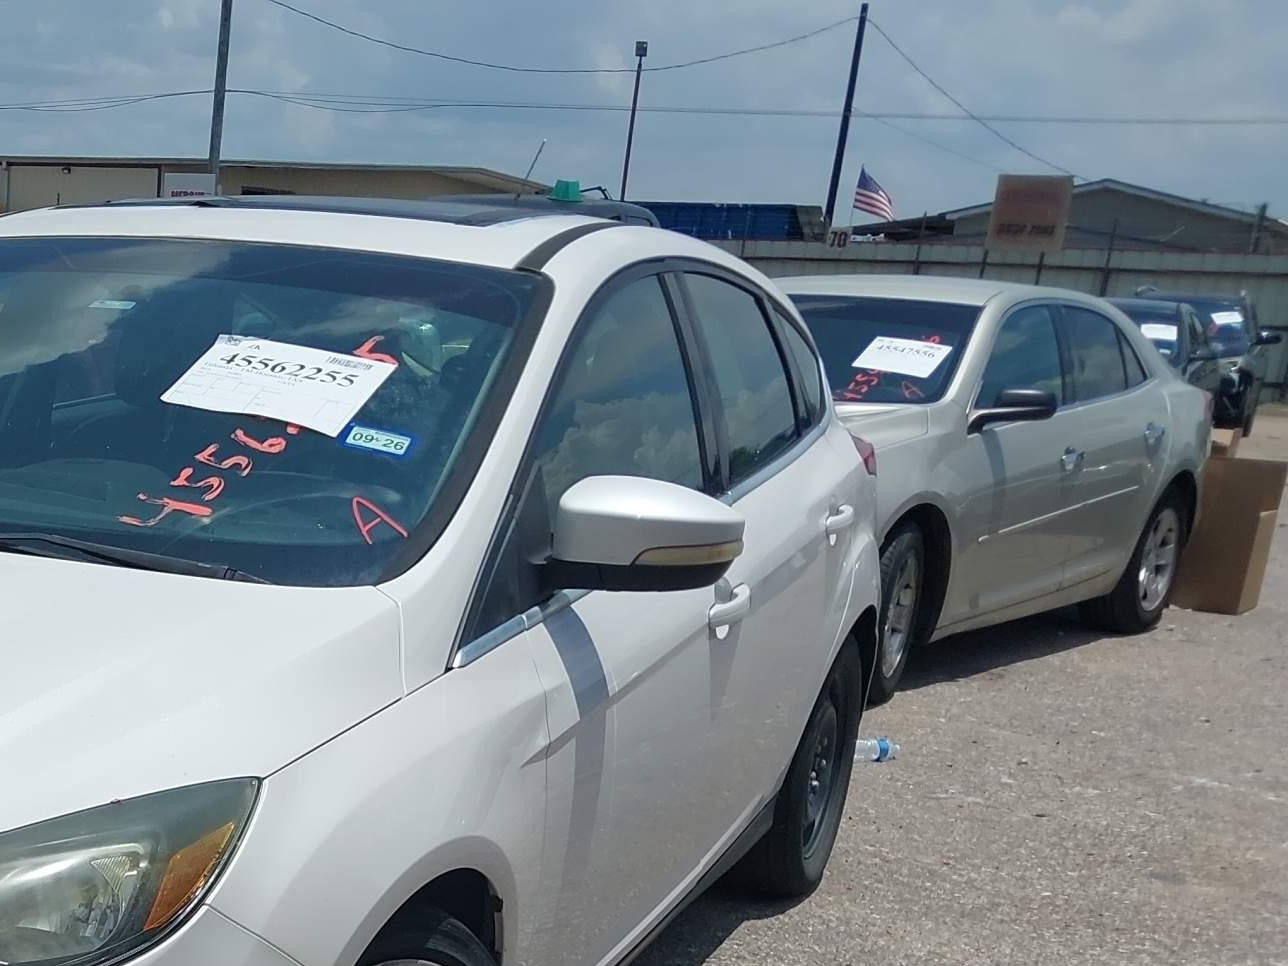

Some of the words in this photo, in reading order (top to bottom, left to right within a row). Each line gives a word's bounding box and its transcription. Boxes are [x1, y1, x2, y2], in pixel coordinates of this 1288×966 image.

[830, 231, 848, 248] 70
[220, 352, 359, 387] 45562255
[118, 424, 300, 527] 4556
[352, 496, 408, 544] A
